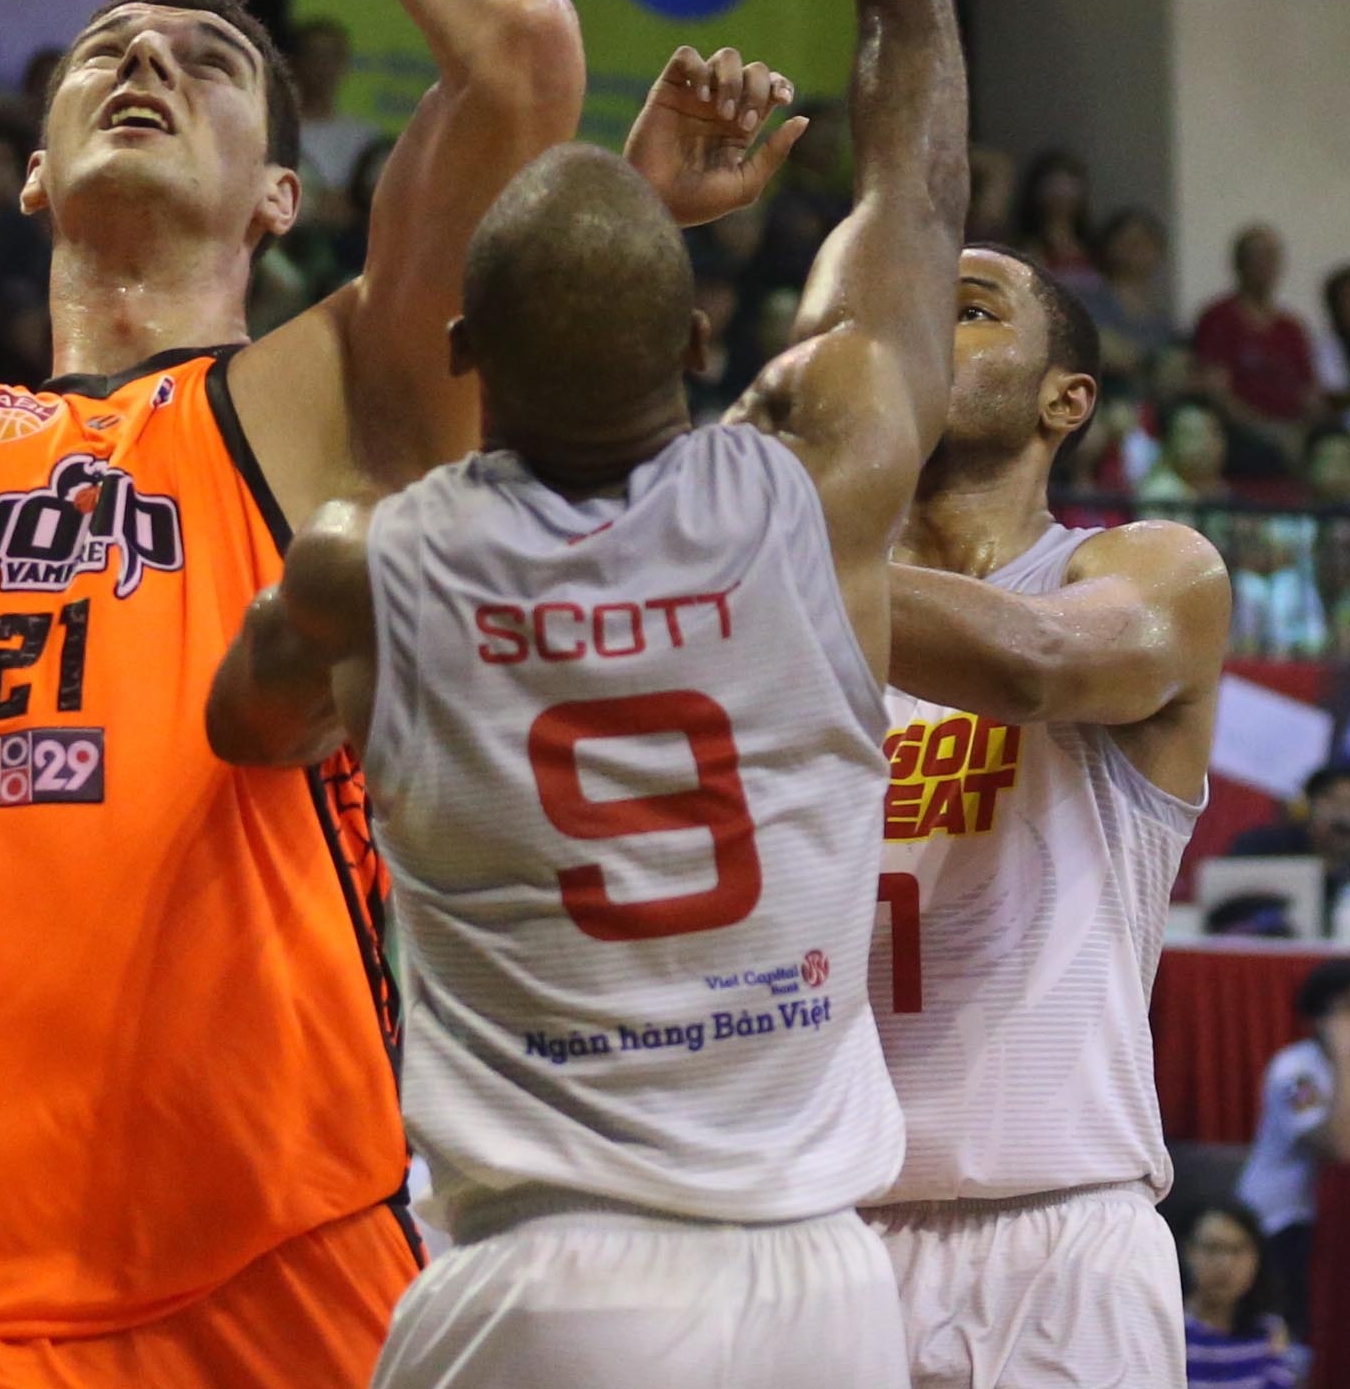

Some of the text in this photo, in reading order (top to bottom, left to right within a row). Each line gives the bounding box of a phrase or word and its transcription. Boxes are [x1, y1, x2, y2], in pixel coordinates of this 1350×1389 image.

[475, 581, 743, 664] SCOTT
[34, 739, 99, 791] 29
[527, 689, 762, 941] 9
